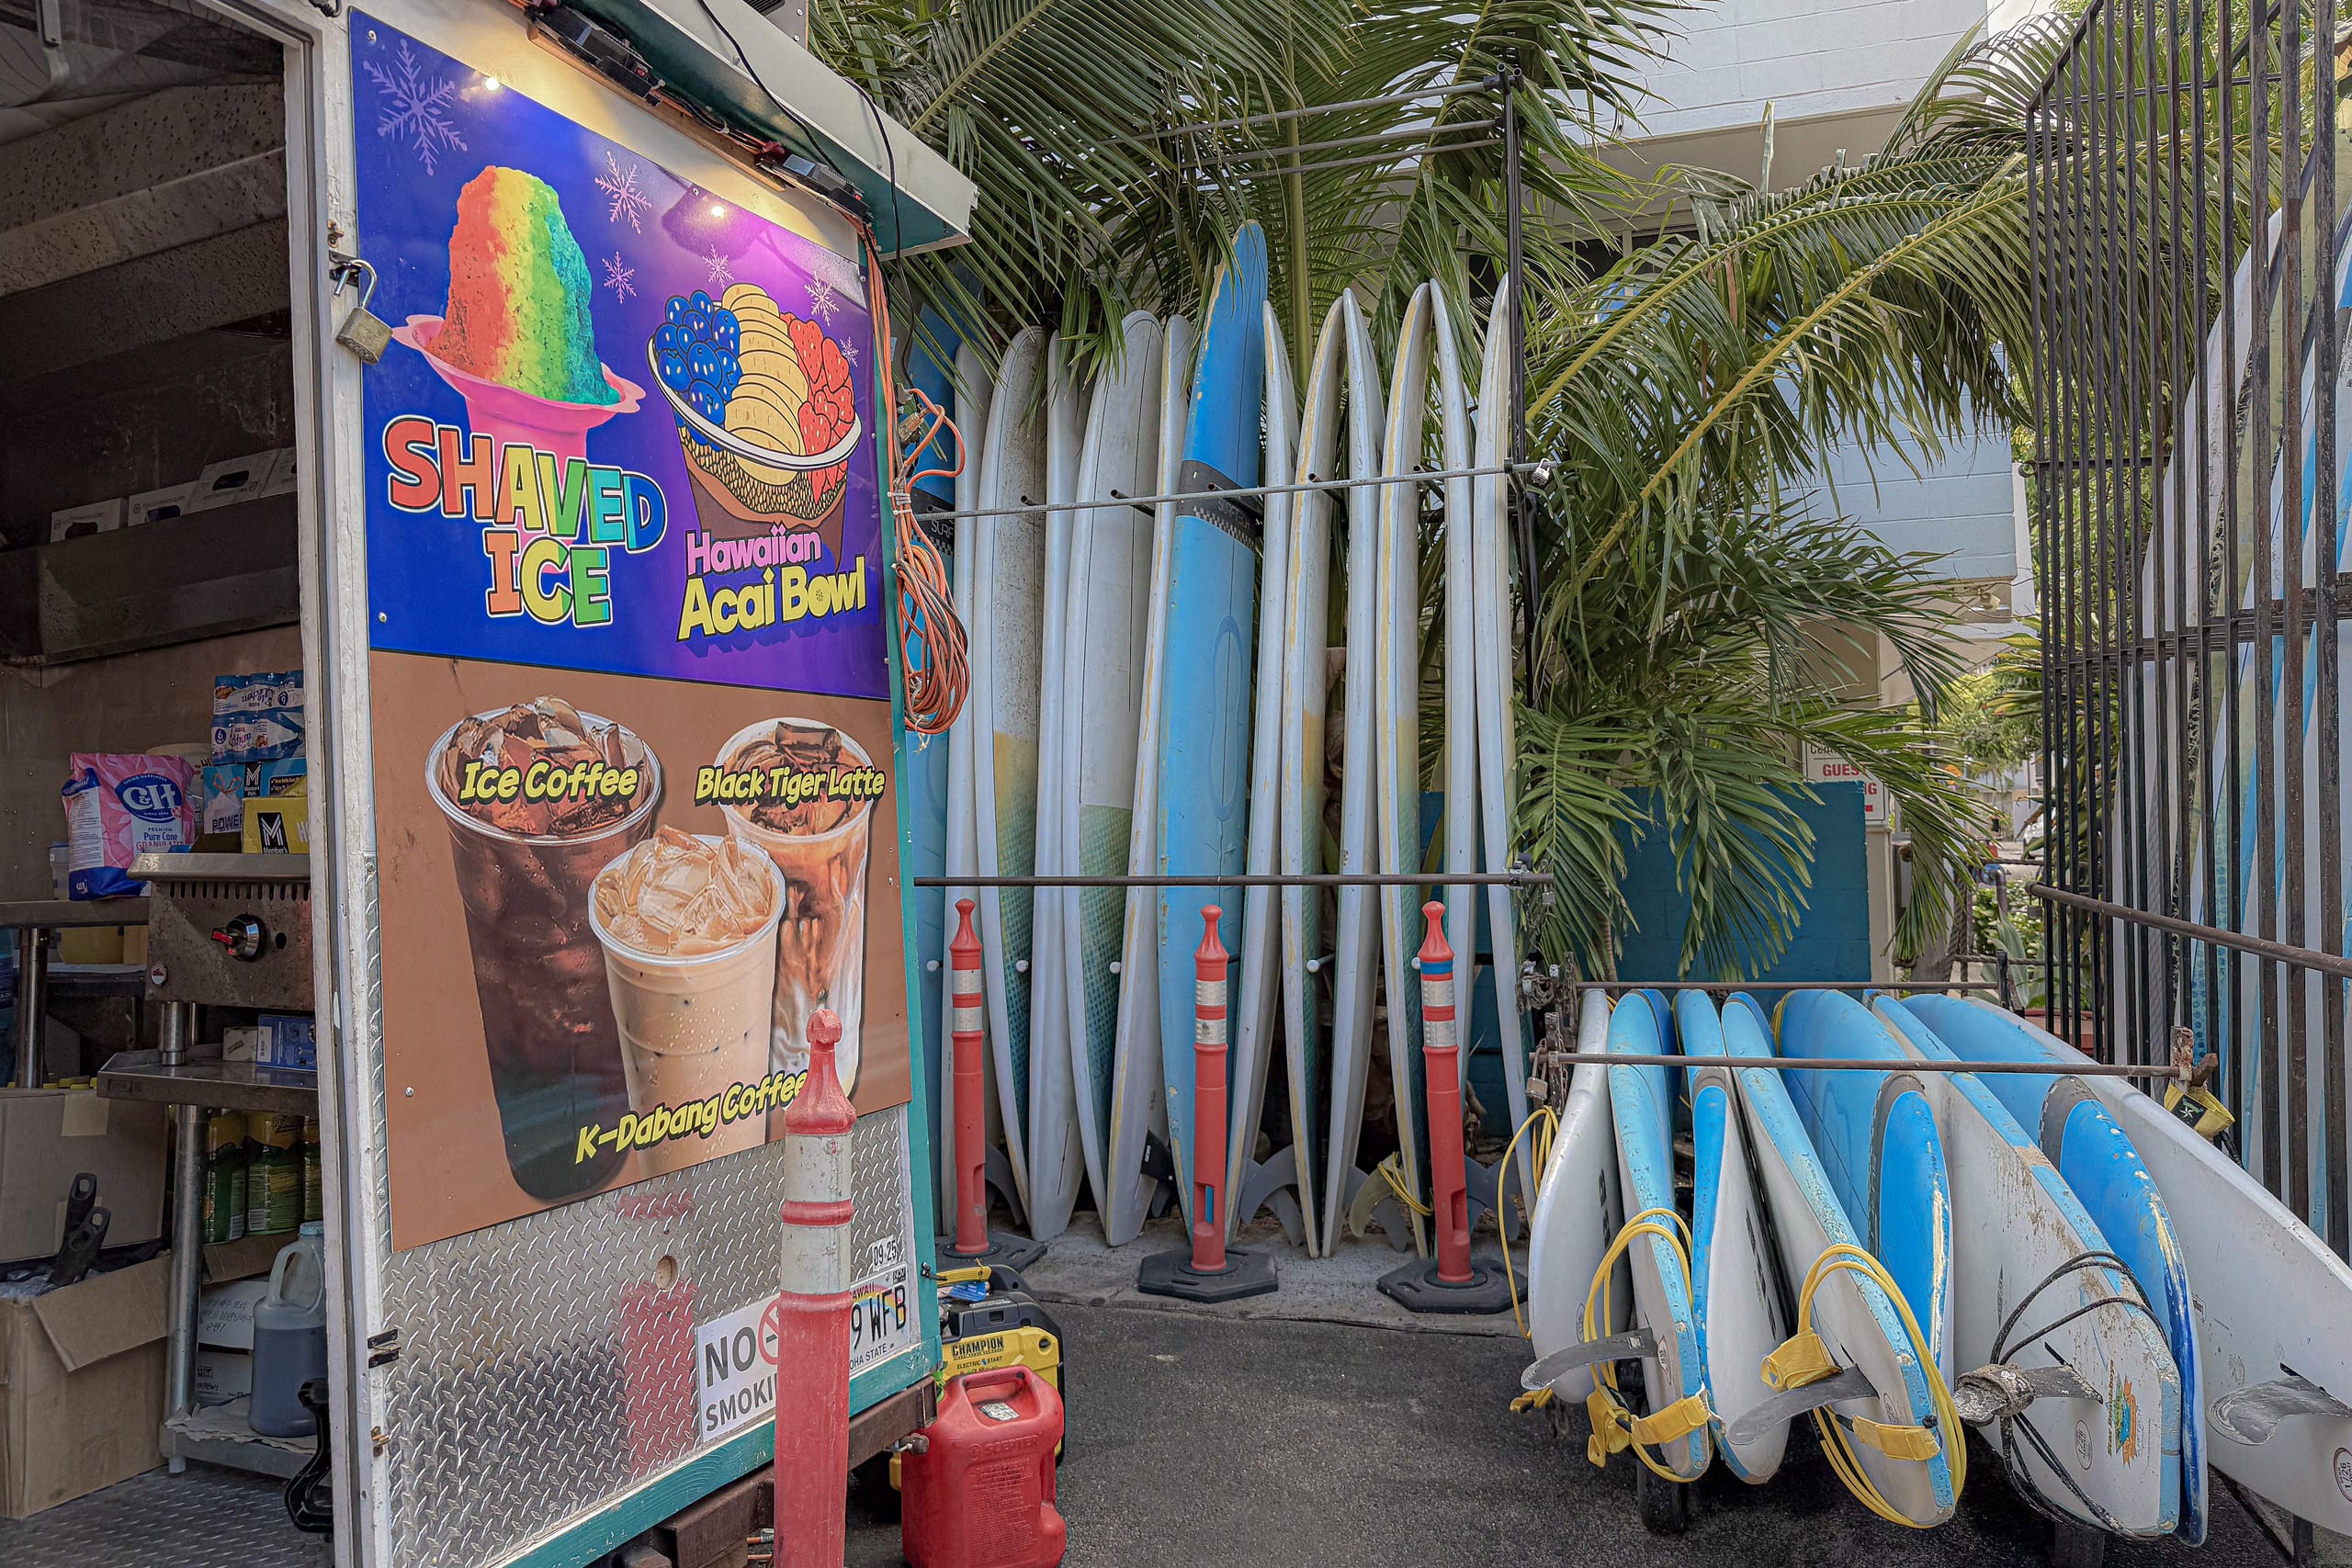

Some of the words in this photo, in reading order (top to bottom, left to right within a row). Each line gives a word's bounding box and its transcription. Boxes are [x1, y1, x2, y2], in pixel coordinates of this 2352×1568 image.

[384, 414, 668, 553] SHAVED
[686, 521, 821, 576] Hawaiian
[484, 527, 614, 627] ICE
[676, 566, 777, 642] Acai
[781, 556, 867, 624] Bowl
[459, 759, 521, 806] Ice
[524, 756, 643, 806] Coffee
[695, 765, 764, 807] Black
[768, 765, 827, 808] Tiger
[825, 765, 887, 807] Latte
[1822, 763, 1866, 777] GUES
[122, 784, 175, 810] C&H
[143, 832, 161, 841] Pure
[575, 1095, 720, 1165] K-Dabang
[850, 1282, 875, 1299] AWAII
[869, 1286, 907, 1342] WFB
[705, 1326, 757, 1388] NO
[849, 1355, 865, 1370] OHA
[865, 1343, 888, 1360] STATE
[952, 1337, 1004, 1357] CHAMPION
[956, 1359, 981, 1370] ELECTRIC
[706, 1373, 778, 1432] SMOKI
